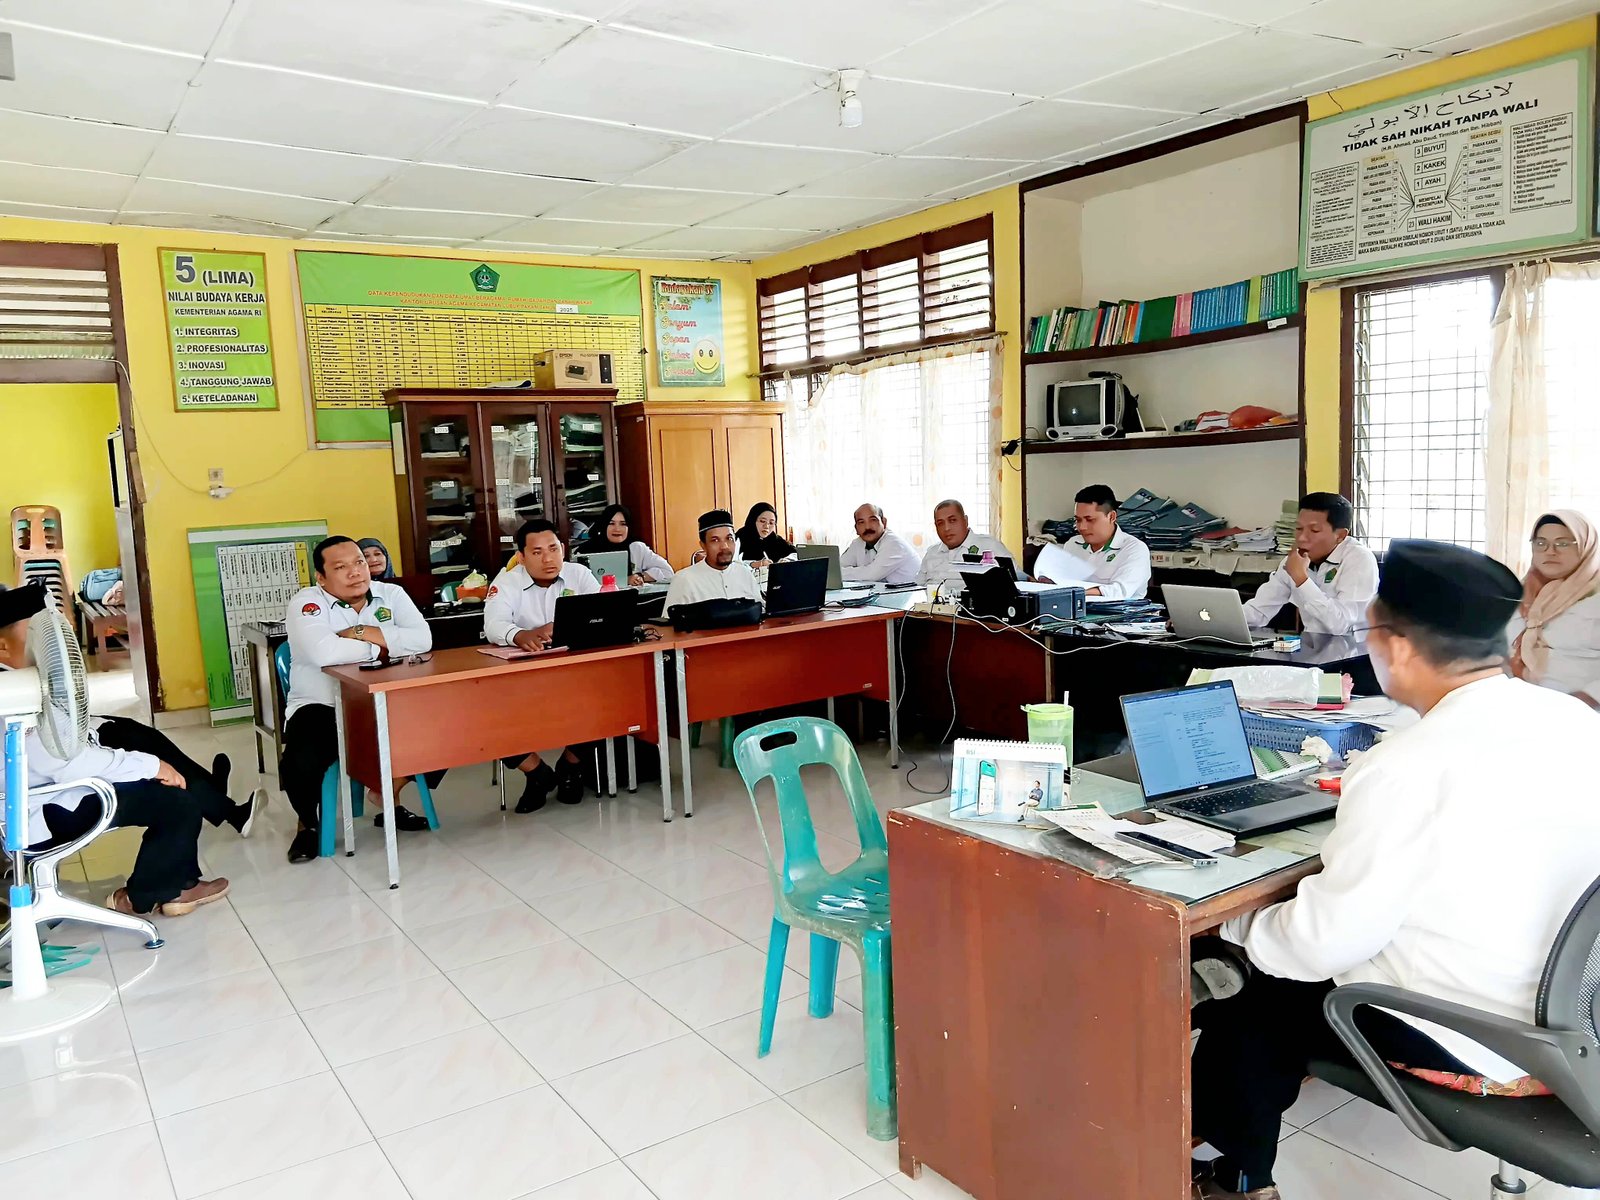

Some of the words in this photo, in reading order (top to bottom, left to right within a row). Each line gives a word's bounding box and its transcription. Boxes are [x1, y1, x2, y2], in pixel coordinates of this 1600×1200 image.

[1343, 138, 1378, 152] TIDAK
[1382, 130, 1406, 144] SAH
[1410, 120, 1450, 136] NIKAH
[1454, 108, 1498, 126] TANPA
[1502, 98, 1538, 114] WALI
[1424, 143, 1444, 153] BUYUT
[1424, 160, 1445, 169] KAKEK
[1425, 177, 1441, 185] AYAH
[1418, 217, 1431, 226] WALI
[1432, 215, 1450, 224] HAKIM
[176, 256, 196, 282] 5
[202, 271, 254, 287] (LIMA)
[168, 292, 193, 302] NILAI
[196, 292, 232, 302] BUDAYA
[235, 293, 265, 303] KERJA
[192, 394, 256, 402] KETELADANAN
